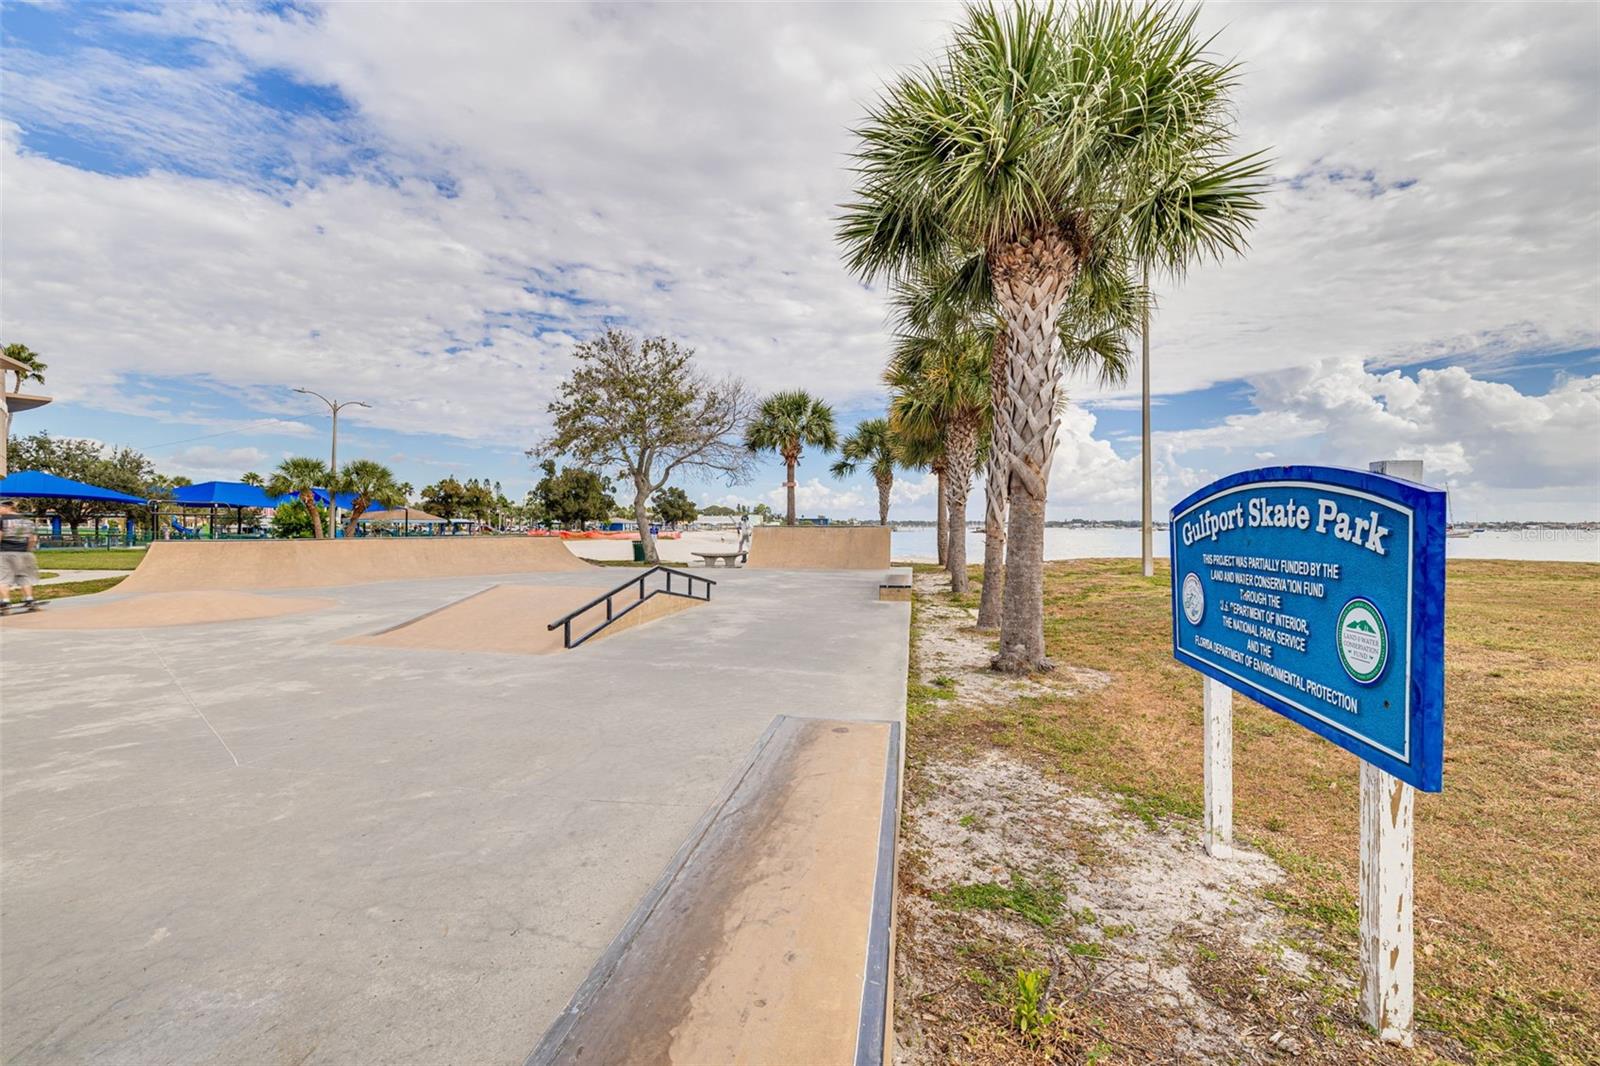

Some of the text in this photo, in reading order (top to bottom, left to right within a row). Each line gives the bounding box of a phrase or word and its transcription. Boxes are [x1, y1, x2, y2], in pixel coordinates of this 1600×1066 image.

[1182, 497, 1389, 555] Gulfport Skate Park
[1203, 553, 1339, 579] THIS PROJECT WAS PARTIALLY FUNDED BY THE
[1210, 569, 1324, 598] LAND AND WATER CONSERVATION FUND
[1240, 588, 1281, 609] THROUGH THE
[1222, 615, 1306, 652] THE NATIONAL PARK SERVICE
[1265, 611, 1275, 624] OF
[1275, 612, 1310, 636] INTERIOR,
[1246, 638, 1272, 658] AND THE
[1194, 634, 1358, 714] FLORIDA DEPARTMENT OF ENVIRONMENTAL PROTECTION
